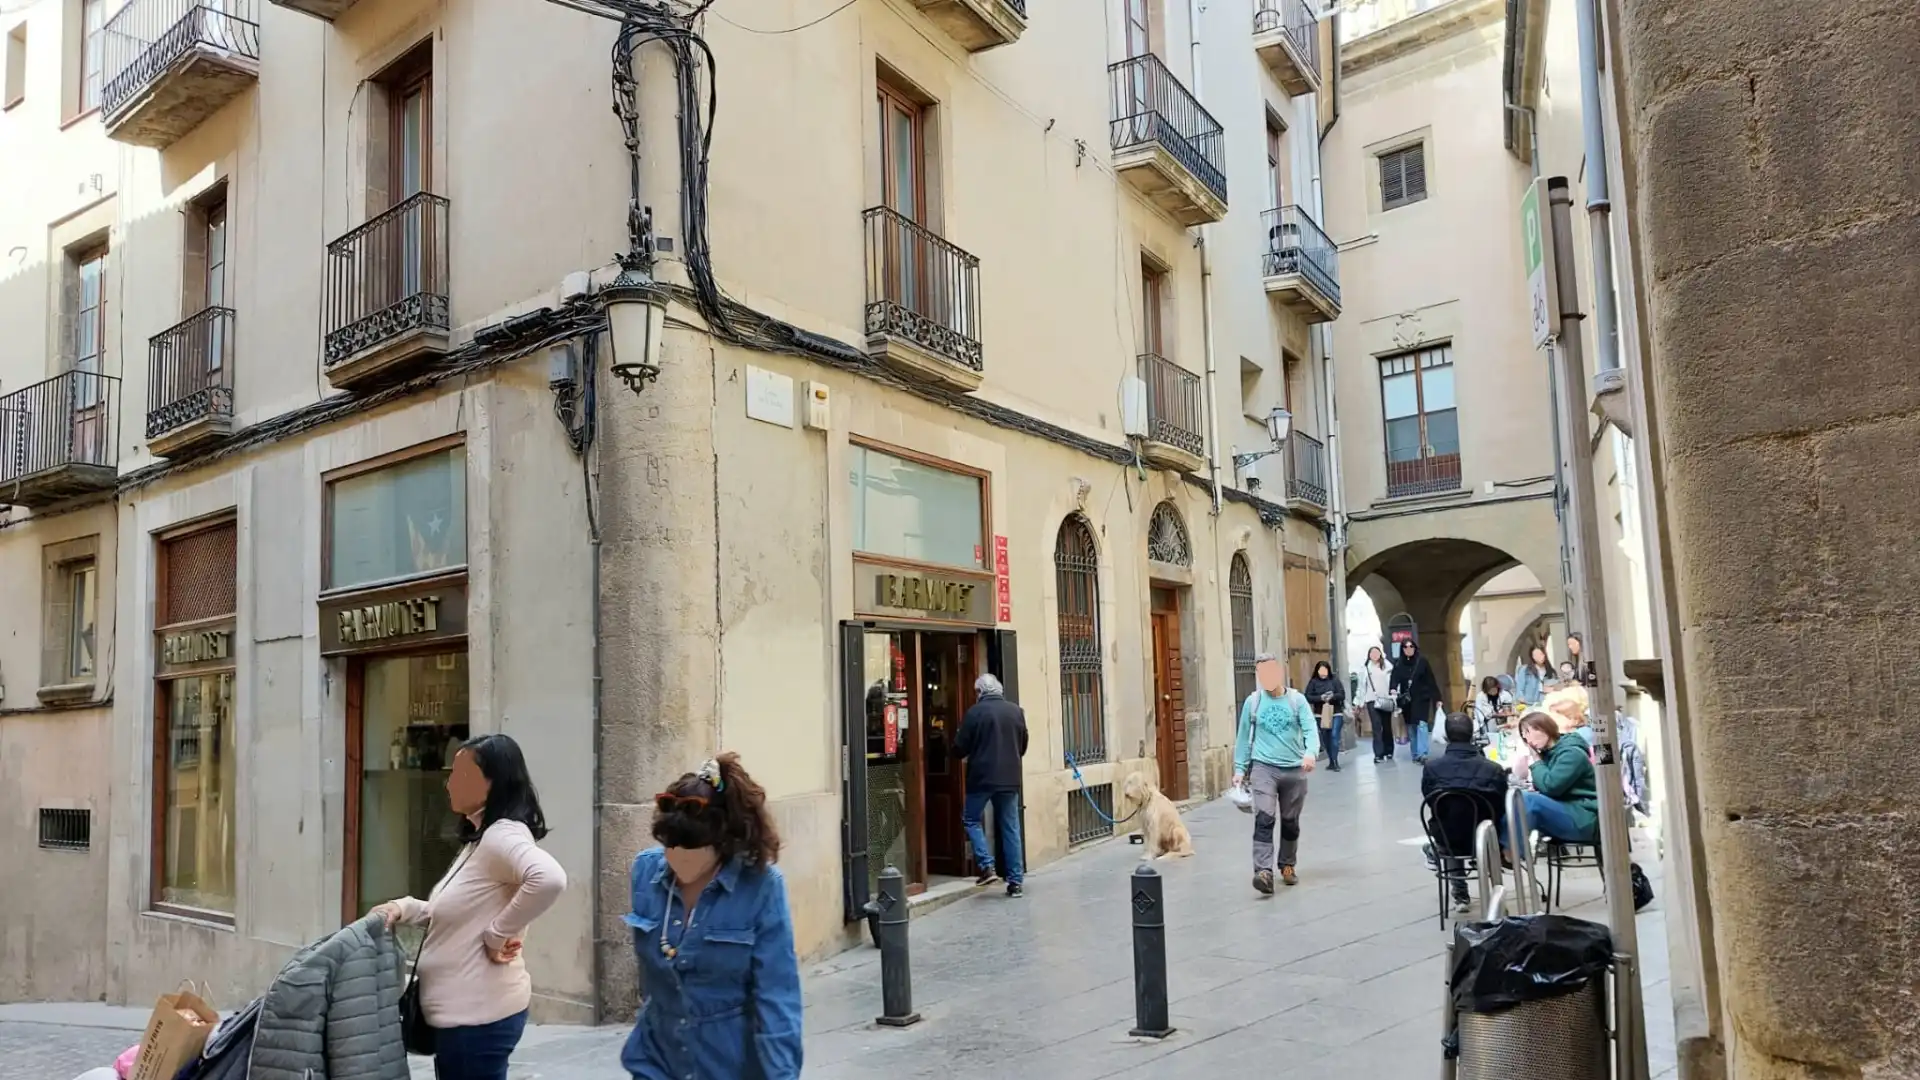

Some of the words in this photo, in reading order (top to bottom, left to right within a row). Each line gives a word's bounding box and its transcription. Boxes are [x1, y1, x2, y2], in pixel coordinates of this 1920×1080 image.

[1526, 208, 1537, 272] P
[878, 573, 974, 613] BARMUTET
[337, 595, 440, 643] BARMUTET
